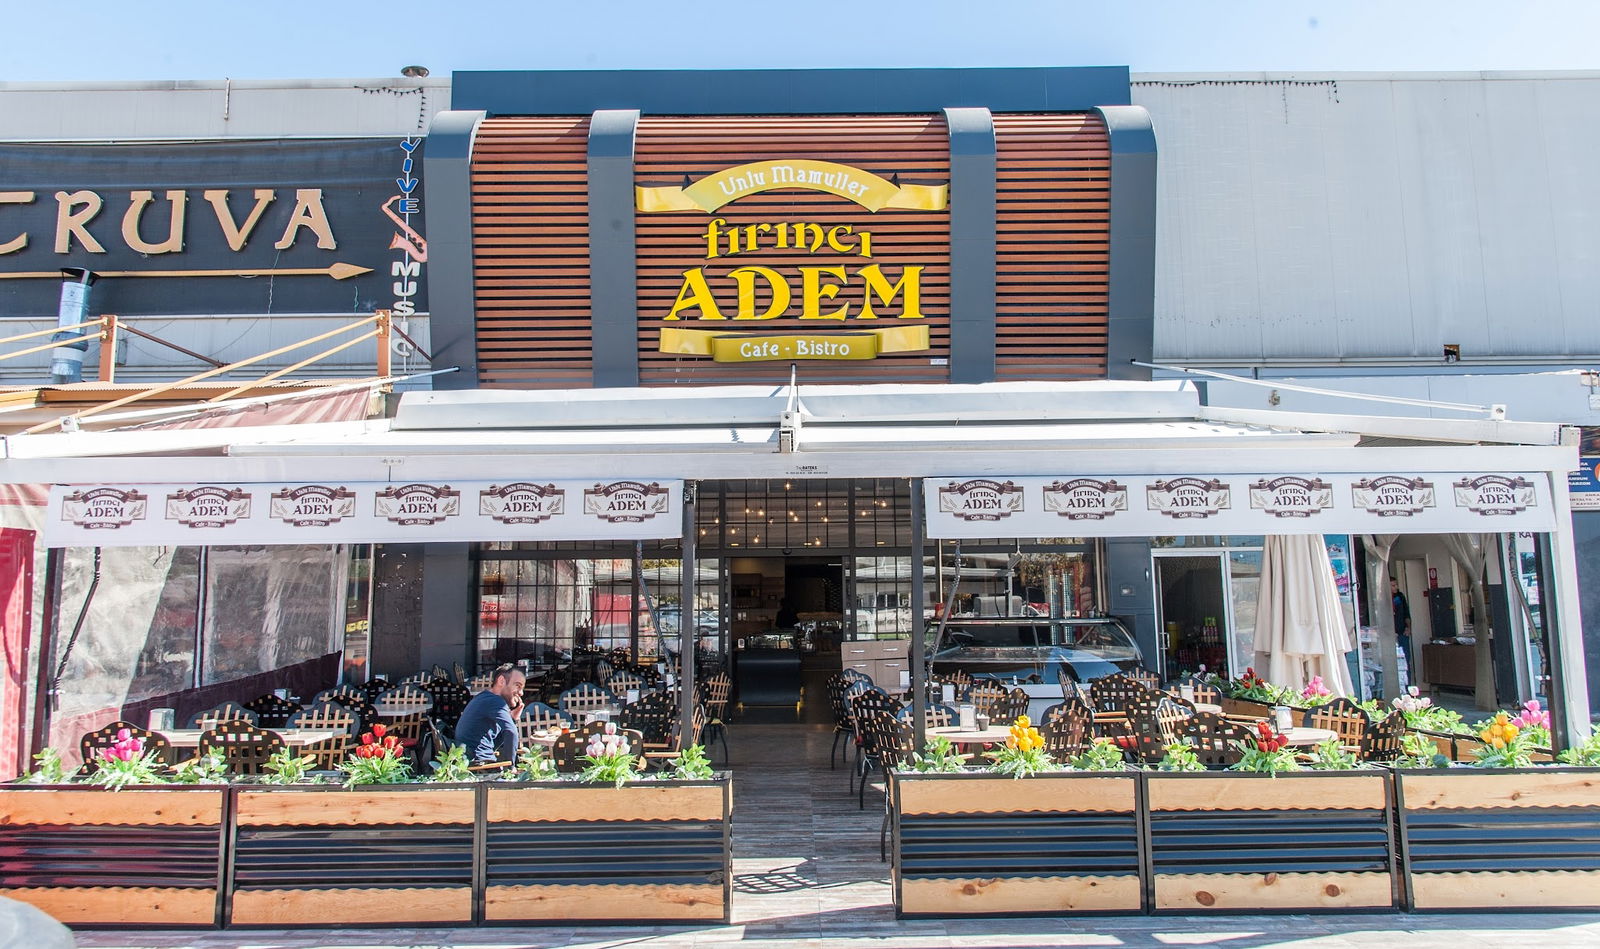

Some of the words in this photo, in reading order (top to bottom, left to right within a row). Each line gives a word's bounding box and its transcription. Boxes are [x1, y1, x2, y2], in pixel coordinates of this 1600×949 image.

[718, 171, 766, 196] Unlu
[771, 165, 870, 198] Mamuller
[662, 263, 926, 322] ADEM
[391, 261, 421, 357] MUSIC
[740, 342, 779, 358] Cafe
[796, 340, 850, 356] Bistro
[962, 499, 1001, 509] ADEM
[1066, 498, 1105, 508] ADEM
[1170, 496, 1208, 507] ADEM
[1272, 496, 1311, 506] ADEM
[1375, 495, 1413, 505] ADEM
[1477, 494, 1514, 504] ADEM
[293, 504, 332, 515] ADEM
[397, 503, 436, 513] ADEM
[502, 502, 541, 512] ADEM
[607, 500, 646, 511] ADEM
[84, 507, 123, 517] ADEM
[188, 506, 227, 516] ADEM
